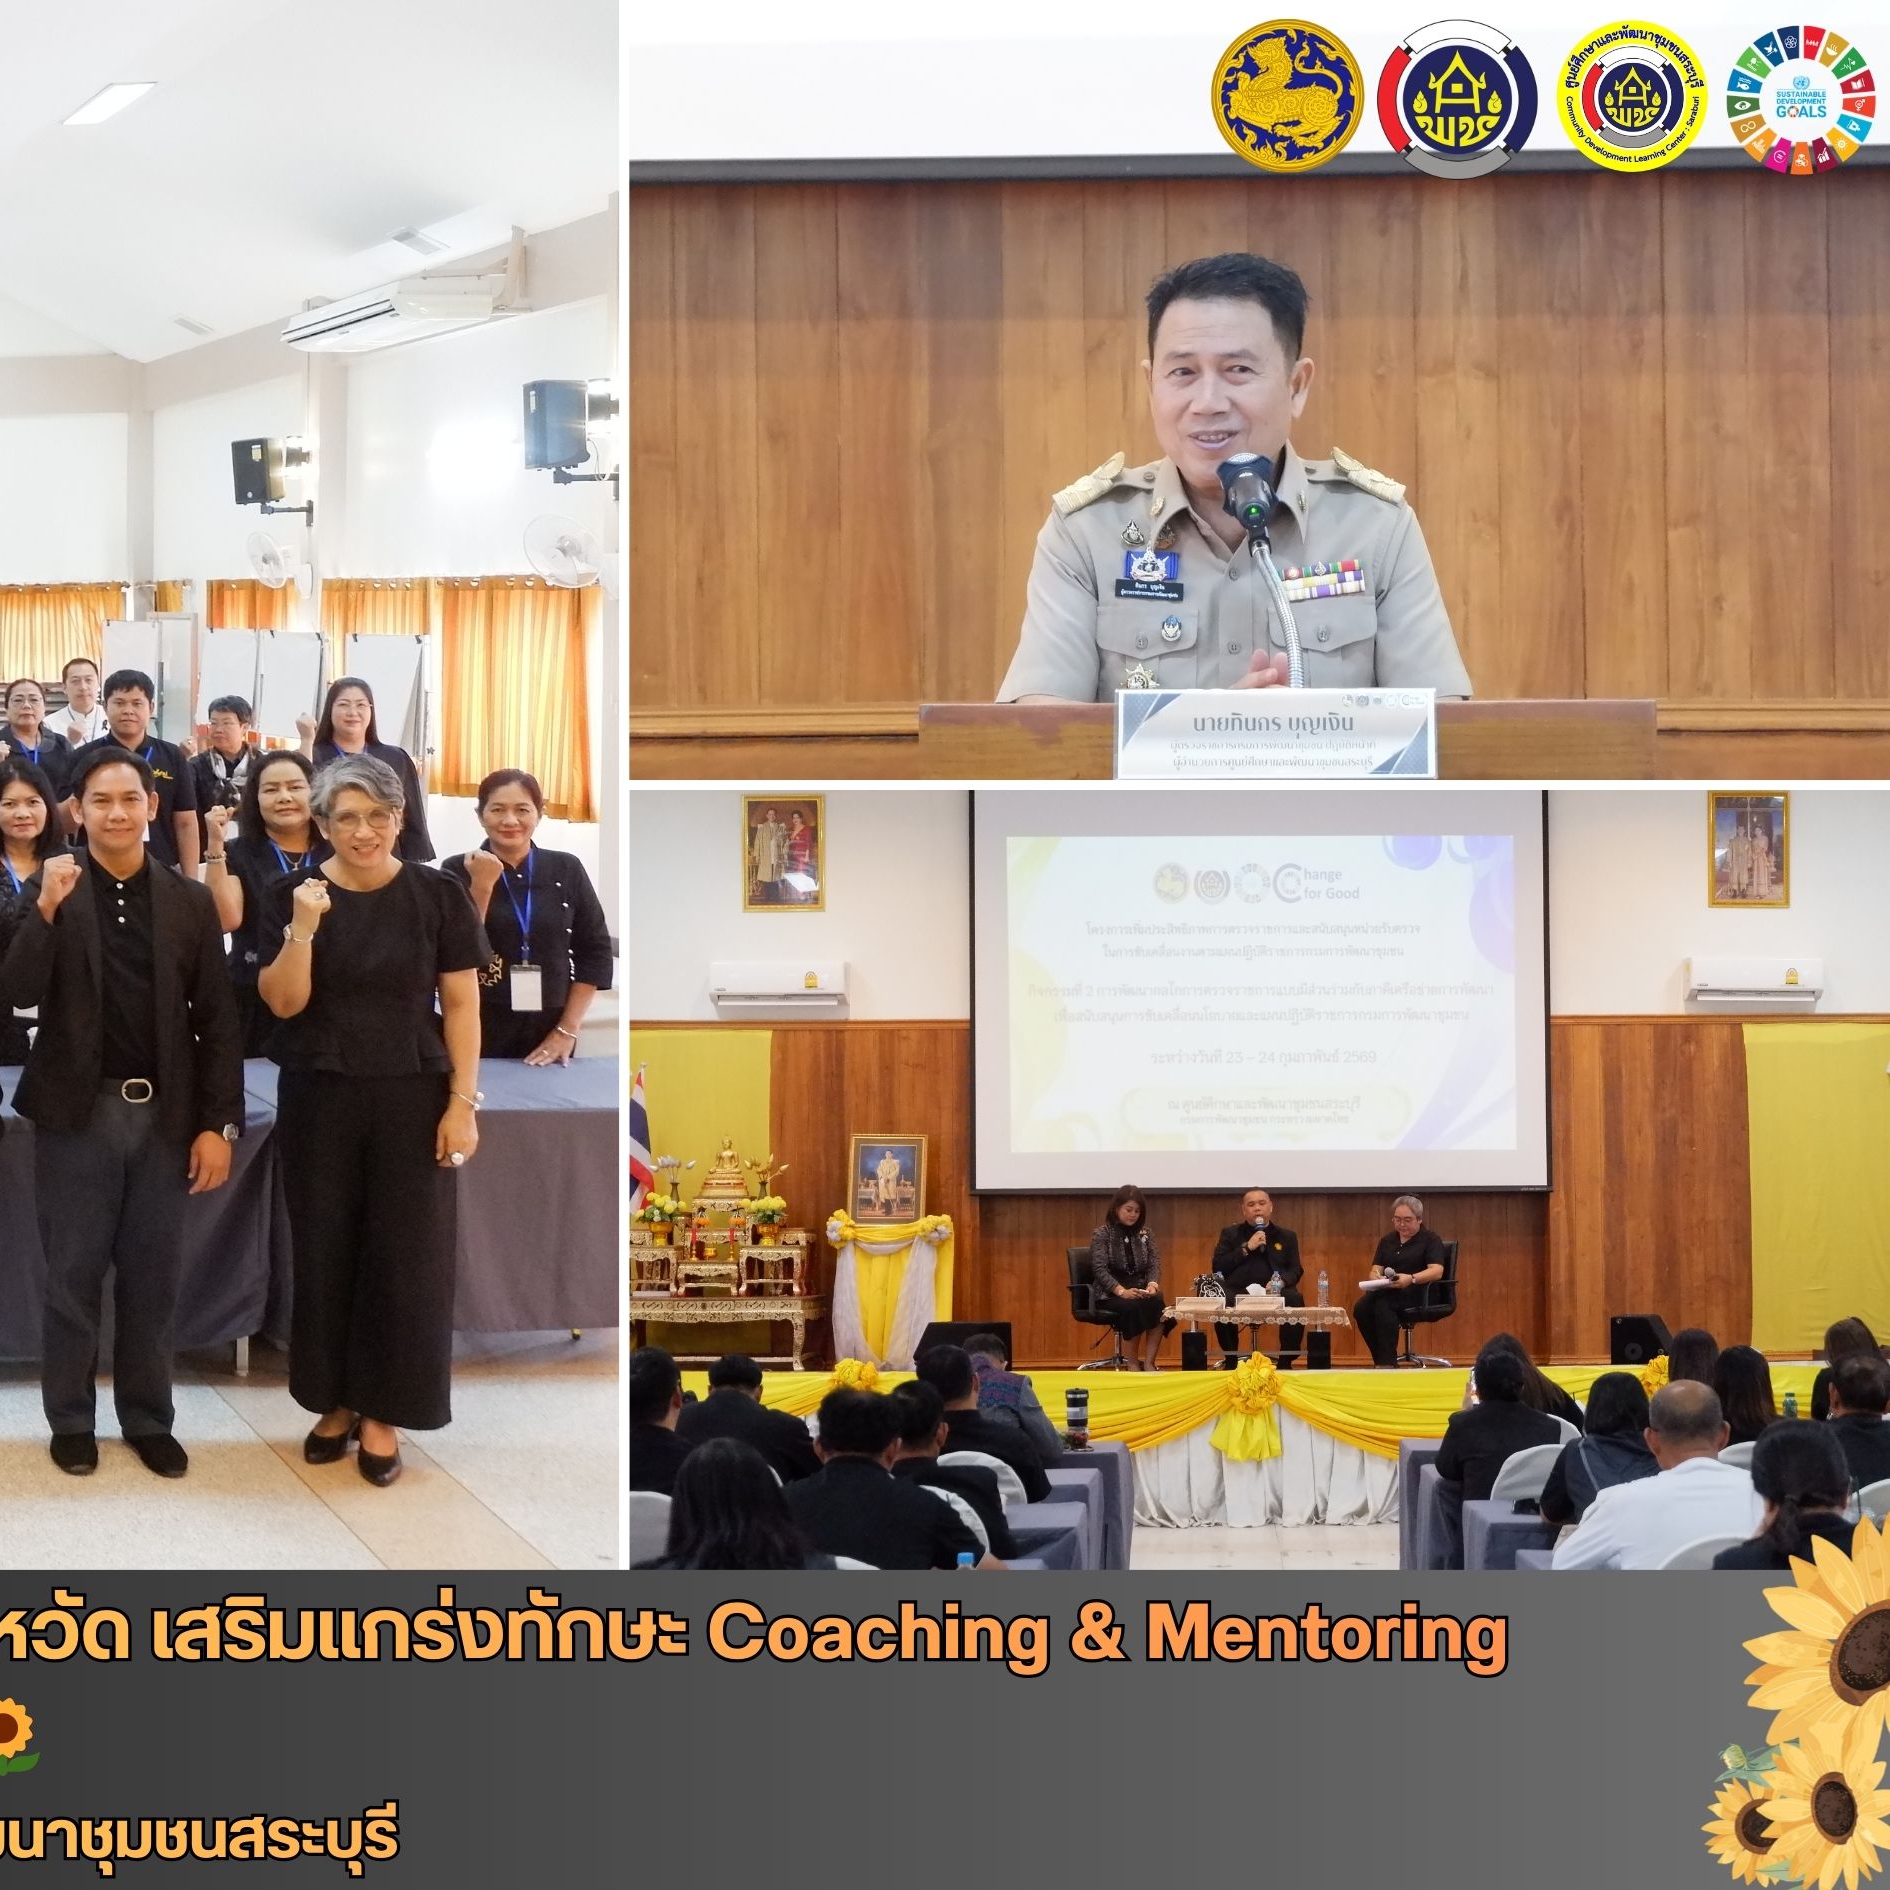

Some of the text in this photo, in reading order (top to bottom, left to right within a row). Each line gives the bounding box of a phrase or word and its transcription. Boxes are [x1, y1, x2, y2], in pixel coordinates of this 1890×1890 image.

[1193, 711, 1355, 740] นายทินกร บุญเงิน
[1303, 886, 1361, 900] for Good
[1150, 1047, 1223, 1065] ระหว่างวันที่
[1225, 1051, 1243, 1064] 23
[1258, 1051, 1276, 1064] 24
[1279, 1047, 1340, 1068] กุมภาพันธ์
[1342, 1051, 1378, 1064] 2569
